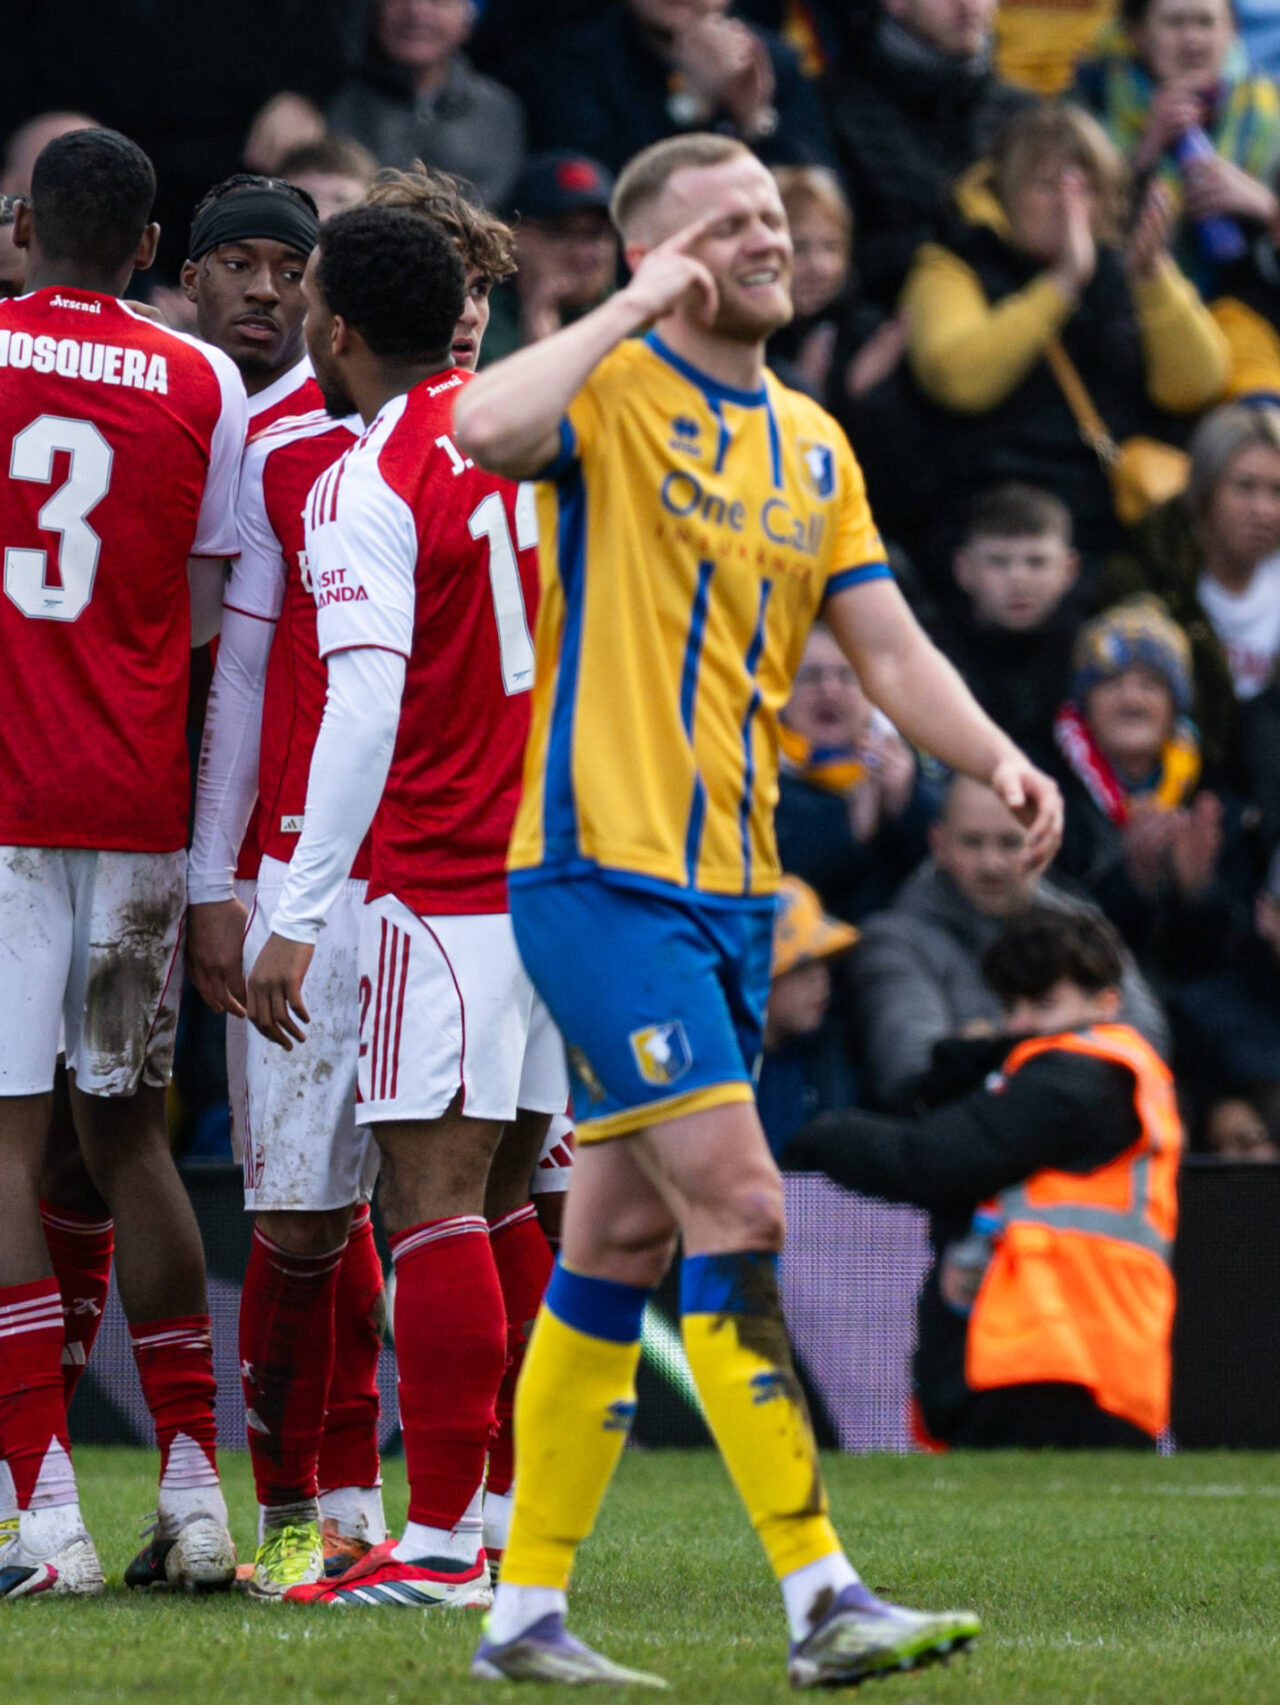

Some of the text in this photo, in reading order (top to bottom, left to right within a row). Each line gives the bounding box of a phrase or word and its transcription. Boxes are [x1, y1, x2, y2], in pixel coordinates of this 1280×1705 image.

[49, 295, 102, 315] Arsenal
[2, 413, 114, 623] 3
[661, 469, 825, 557] One Call
[317, 568, 347, 588] SIT
